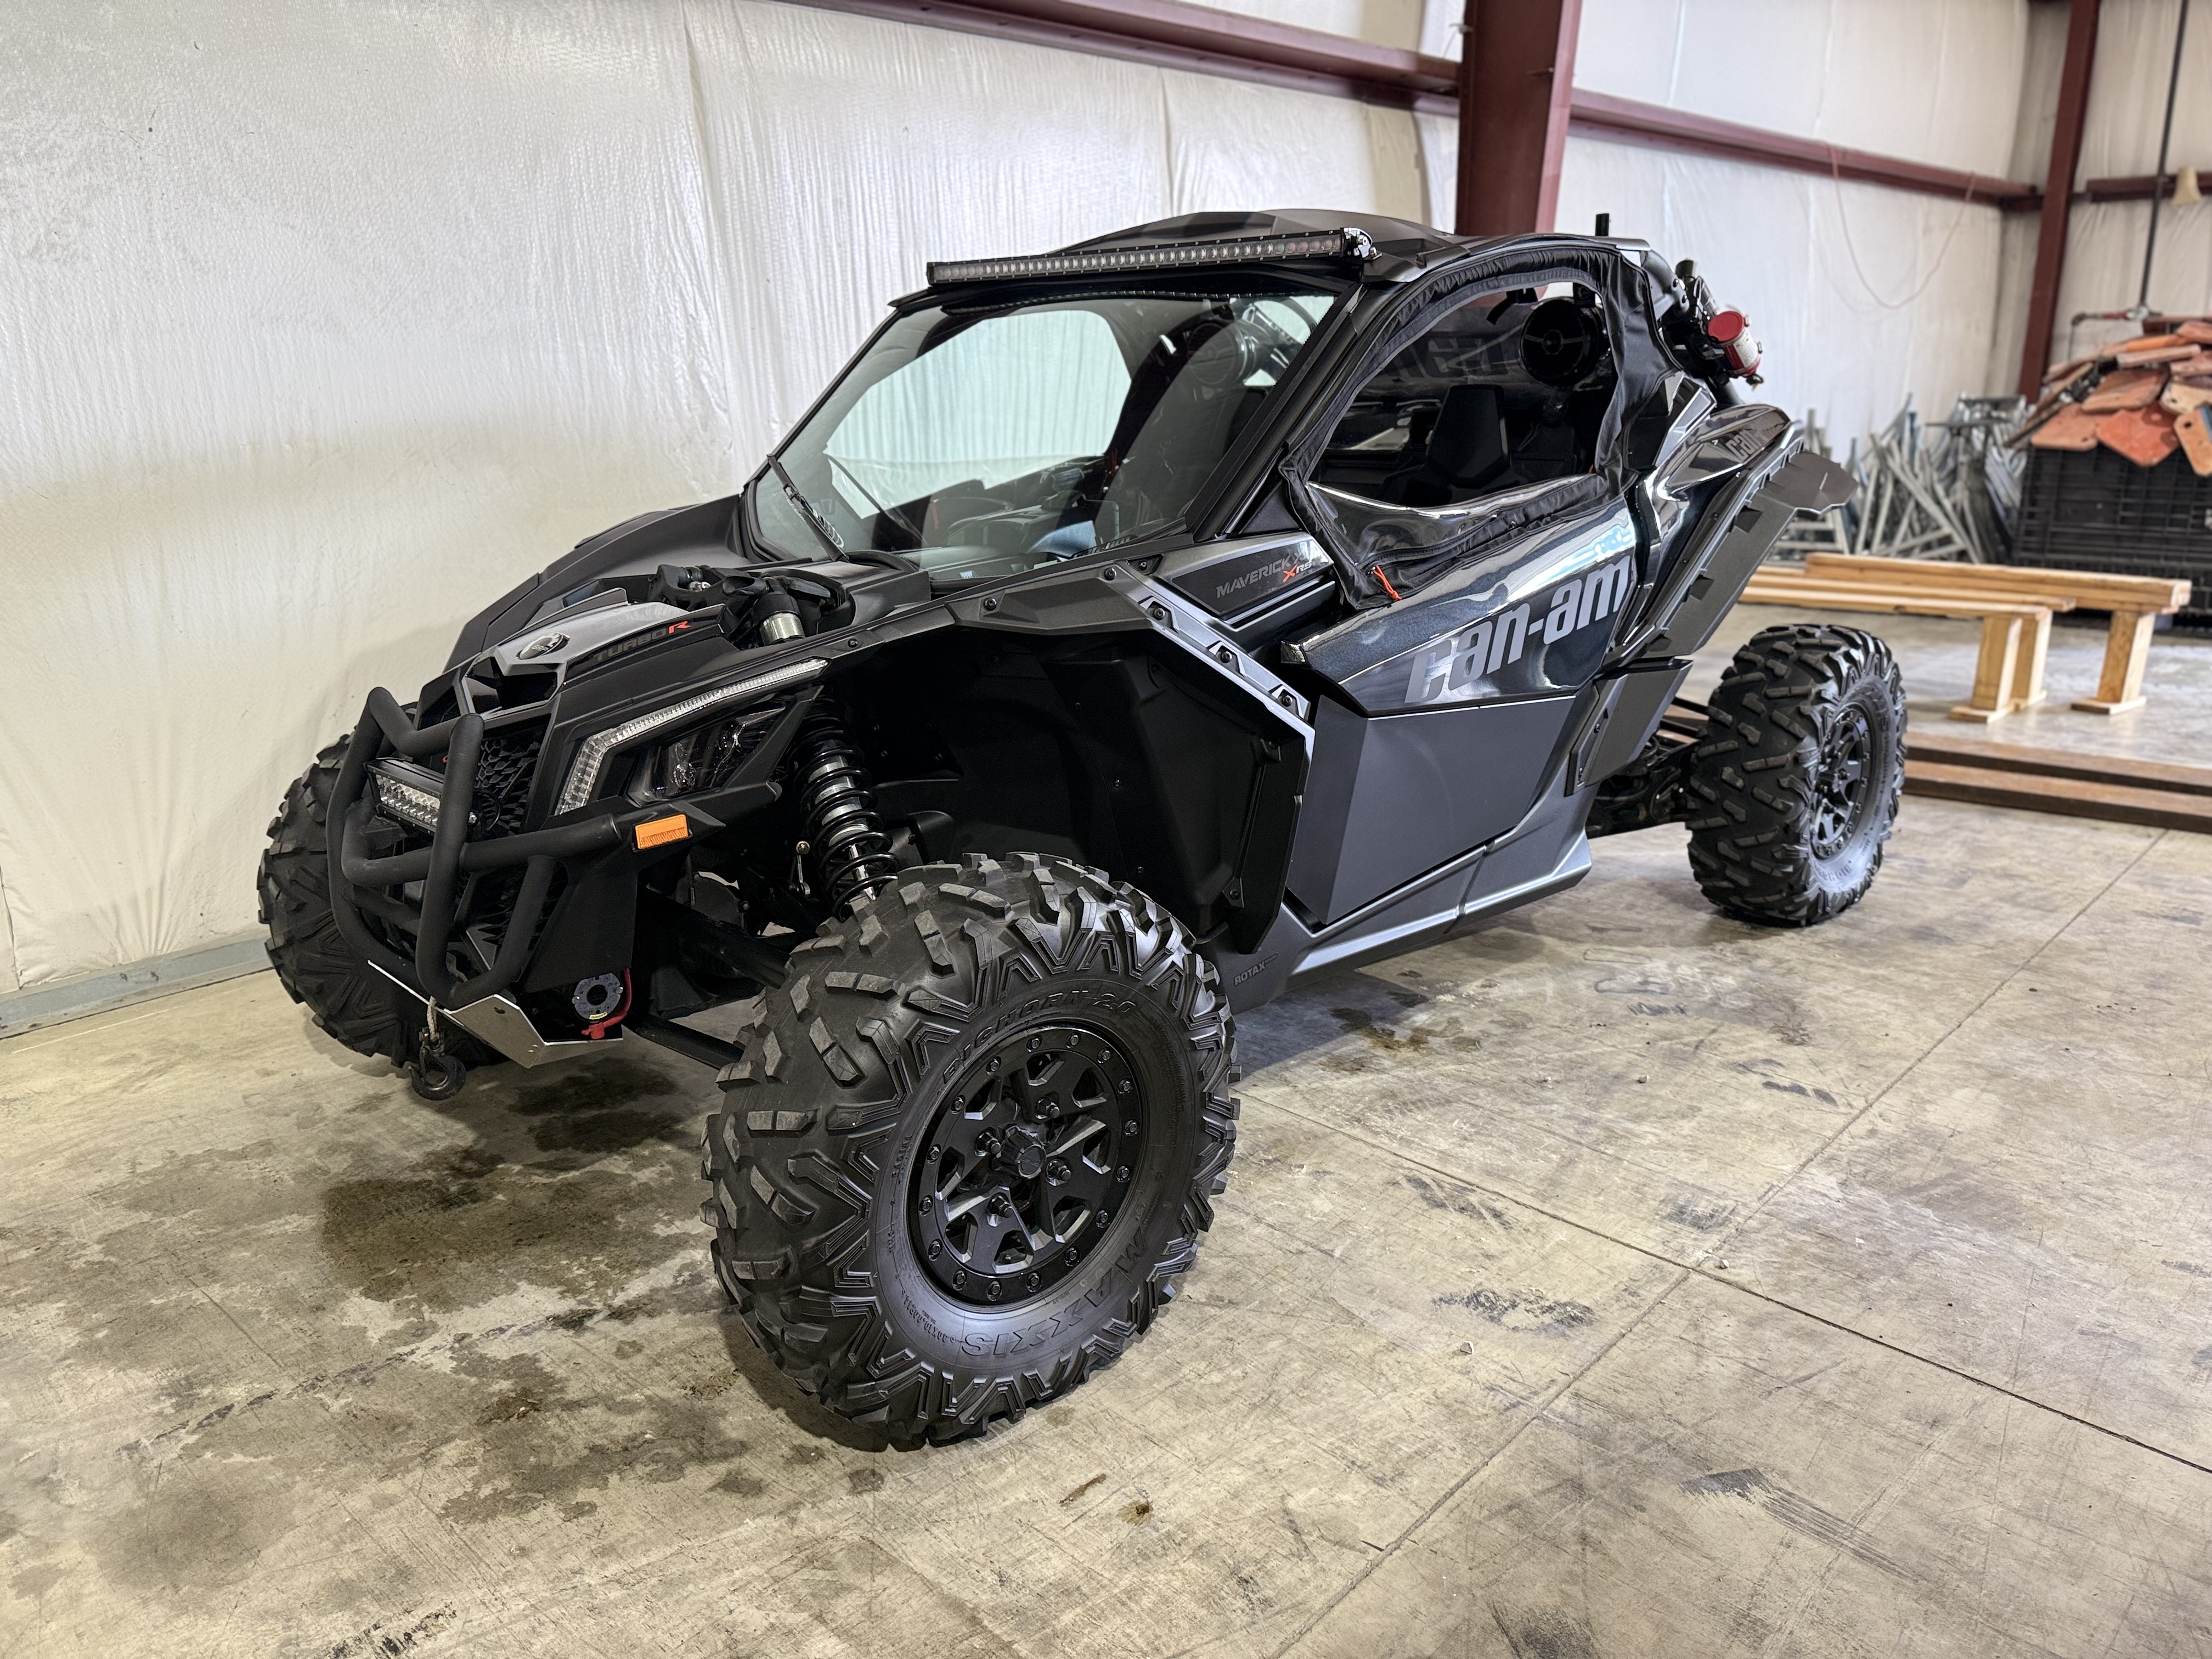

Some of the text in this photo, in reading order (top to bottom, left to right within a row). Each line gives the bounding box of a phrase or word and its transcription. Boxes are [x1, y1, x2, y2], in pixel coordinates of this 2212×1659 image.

[1216, 555, 1291, 598] MAVERICK
[1404, 555, 1631, 703] can-am
[1234, 961, 1266, 986] ROTAX
[961, 1227, 1148, 1358] MAXXIS
